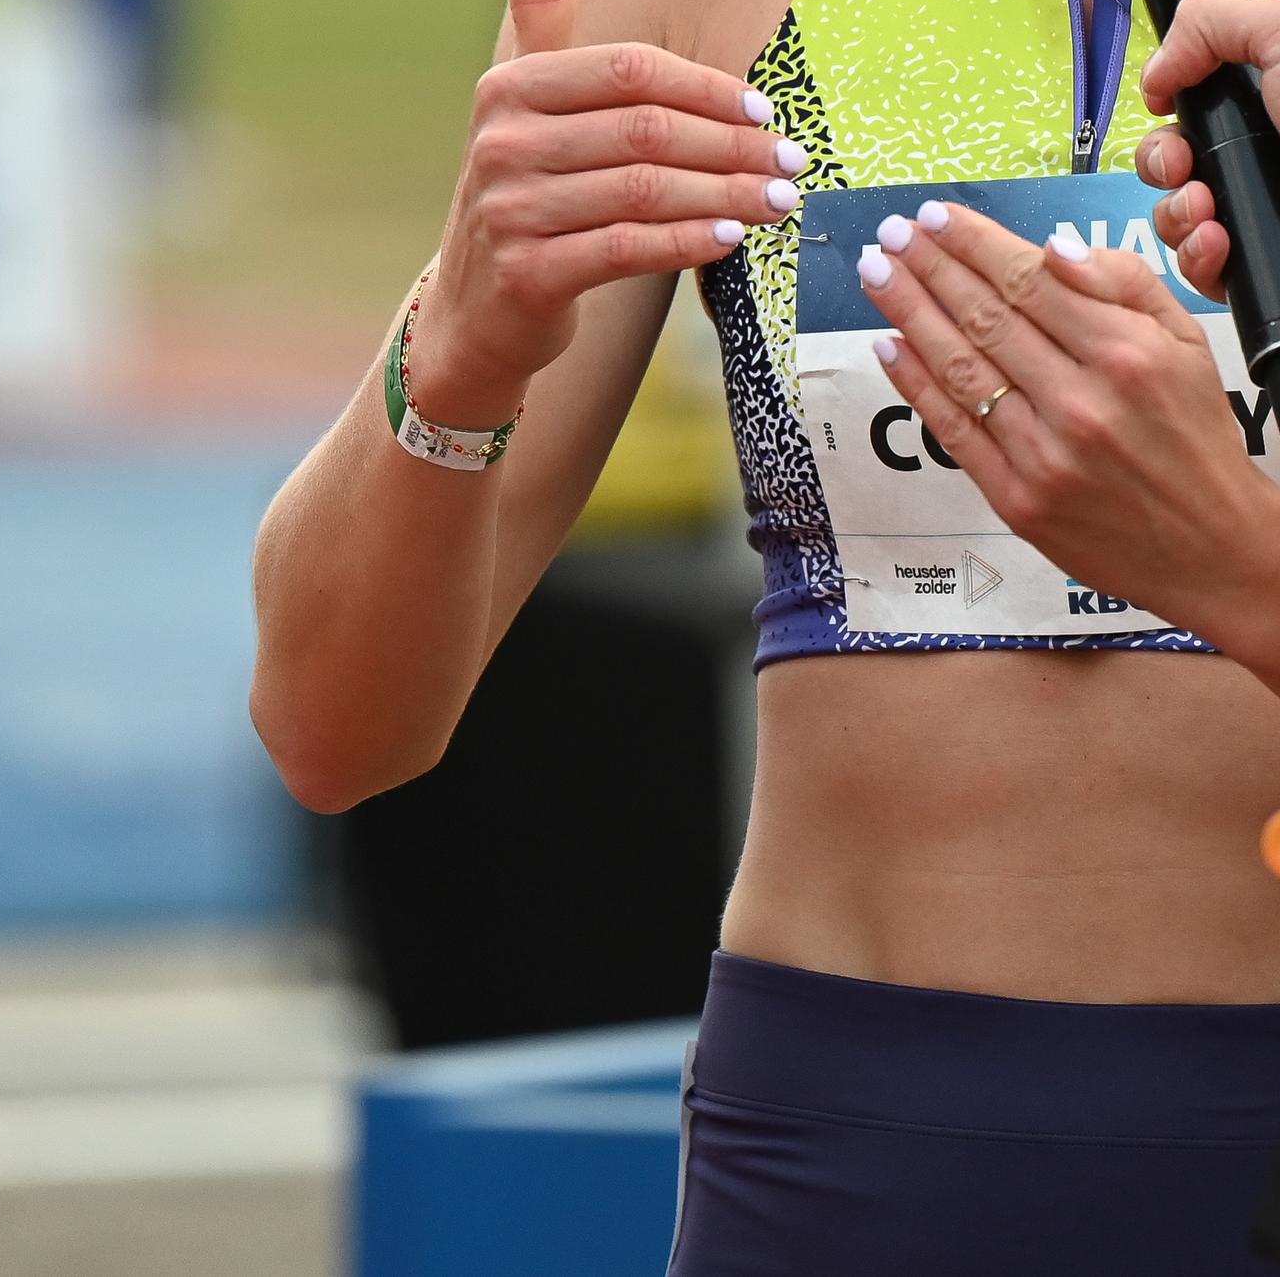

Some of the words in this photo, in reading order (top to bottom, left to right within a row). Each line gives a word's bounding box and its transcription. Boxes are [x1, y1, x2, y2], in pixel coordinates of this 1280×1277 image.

[823, 422, 837, 451] 2030
[894, 563, 956, 579] heusden
[914, 580, 956, 595] zolder
